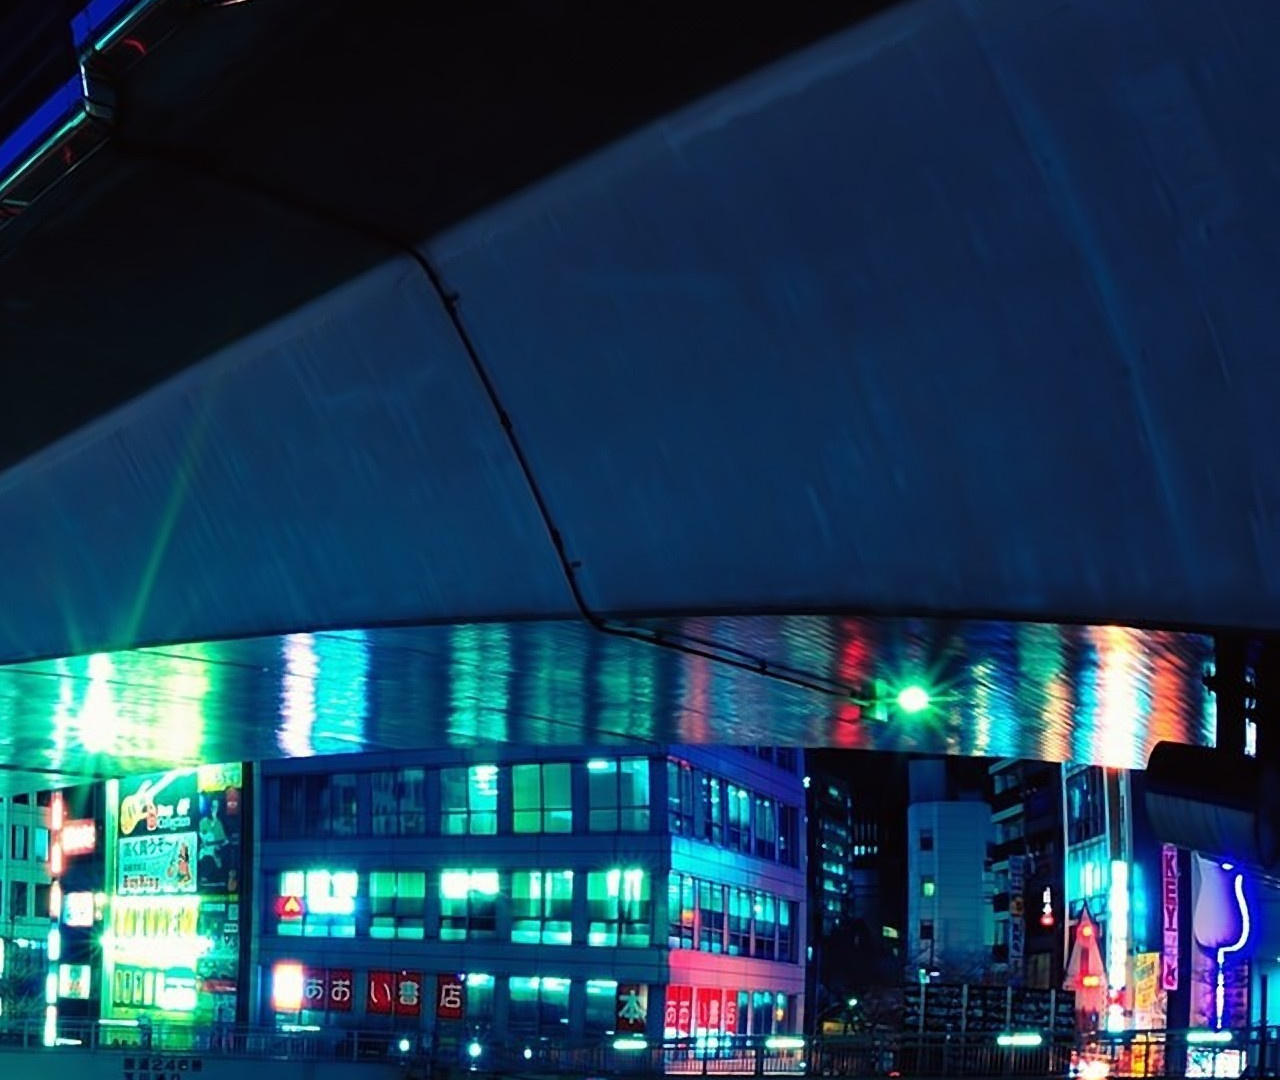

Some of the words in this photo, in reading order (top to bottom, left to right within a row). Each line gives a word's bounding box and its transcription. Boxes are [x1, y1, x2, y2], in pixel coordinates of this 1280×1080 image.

[304, 978, 463, 1009] あおい書店
[618, 989, 647, 1025] 本
